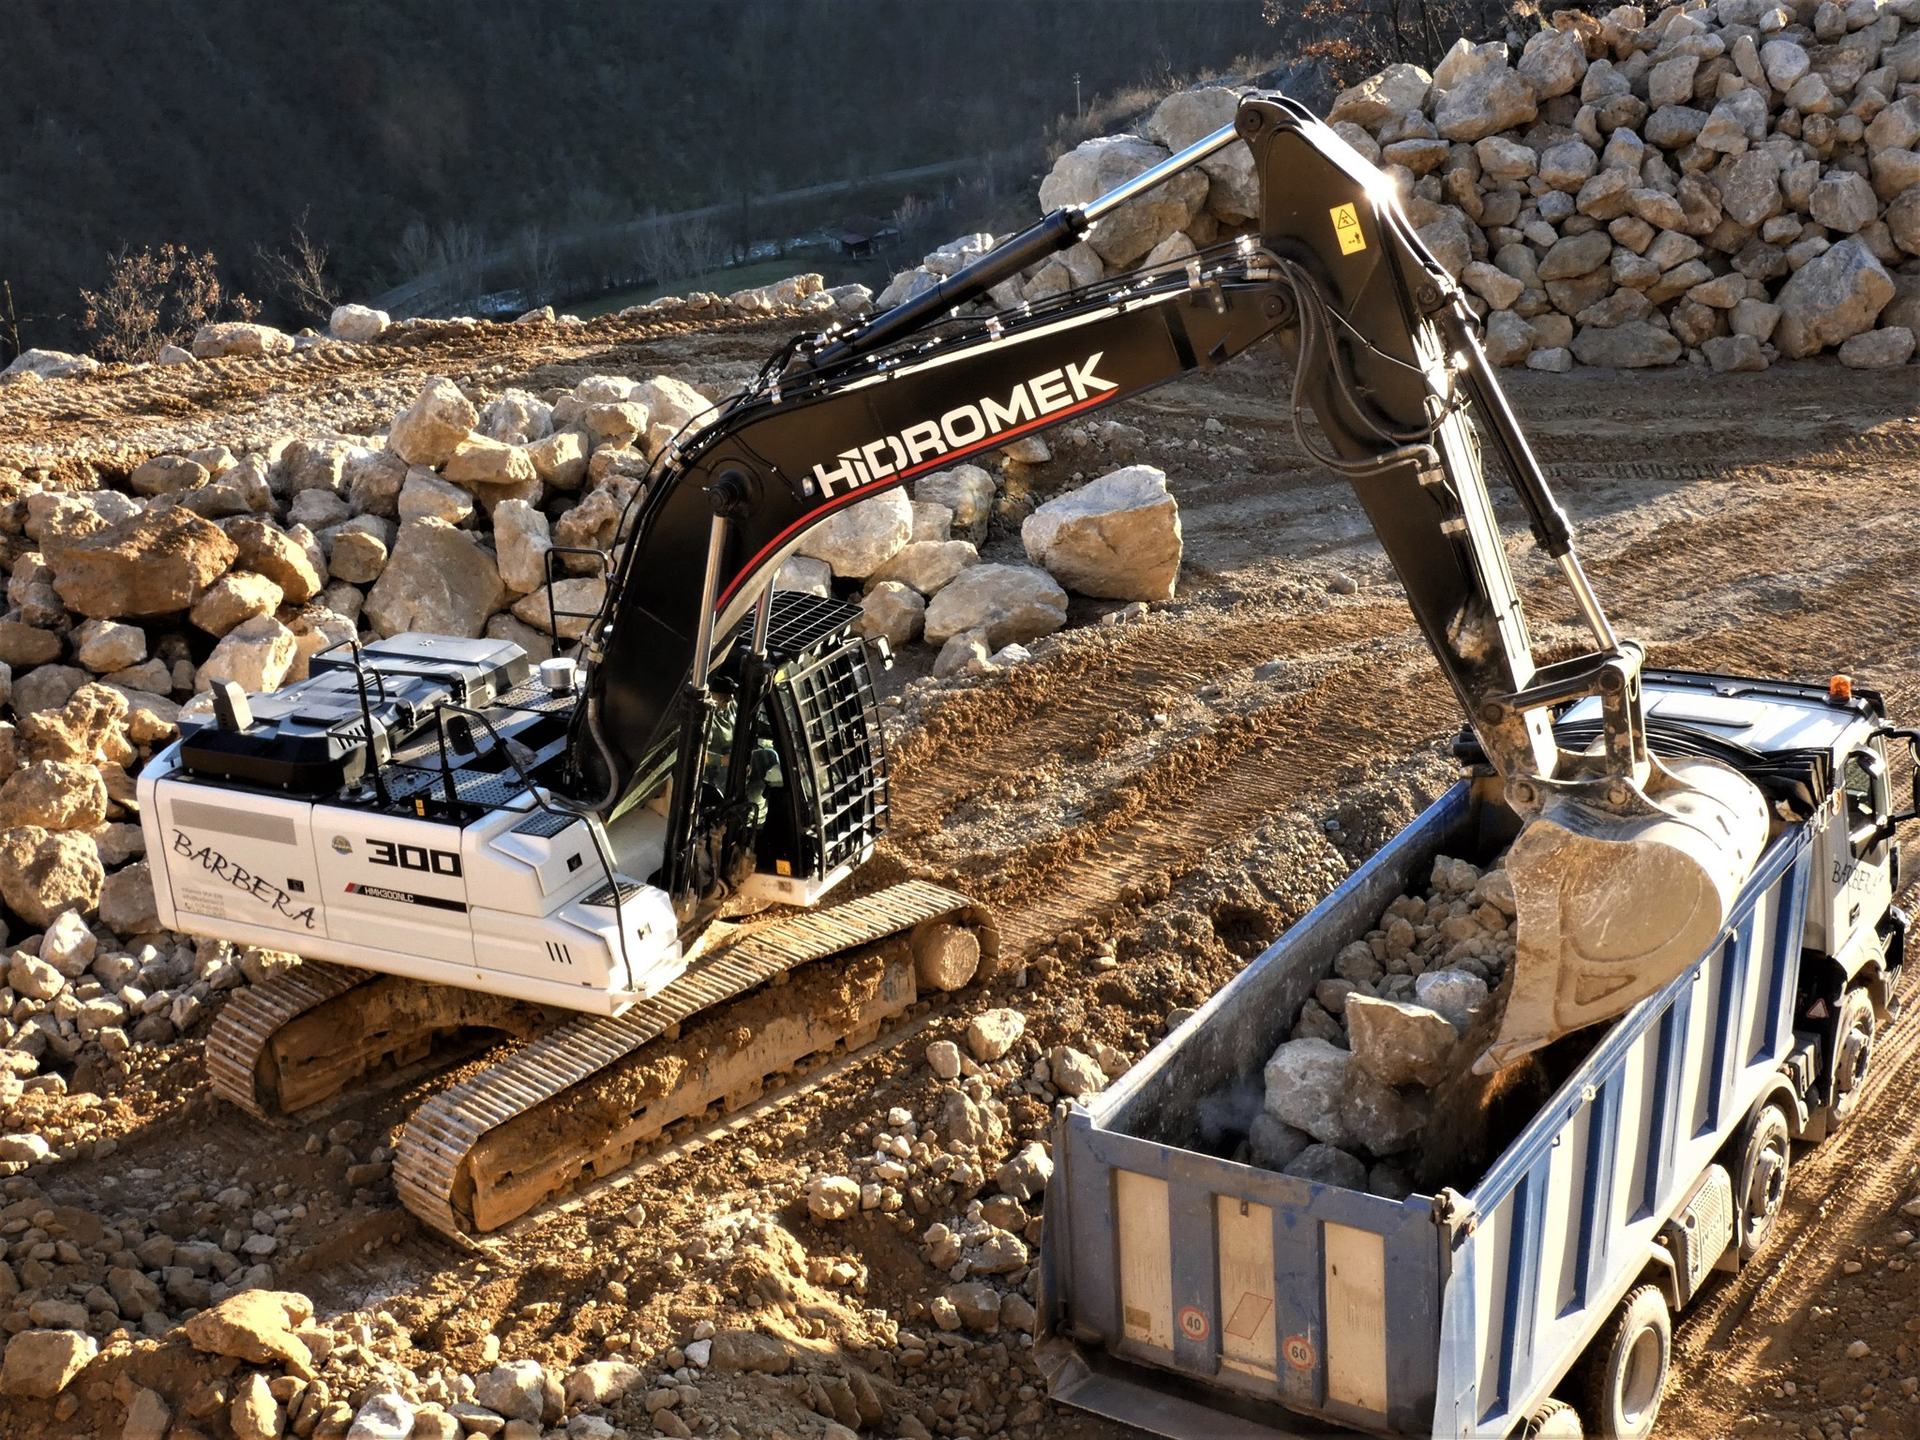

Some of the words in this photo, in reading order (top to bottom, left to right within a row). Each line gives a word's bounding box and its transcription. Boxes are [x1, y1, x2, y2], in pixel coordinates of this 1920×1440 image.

[365, 838, 463, 878] 300
[172, 828, 315, 929] BARBERA
[1186, 1316, 1201, 1331] 40
[1291, 1345, 1307, 1361] 60
